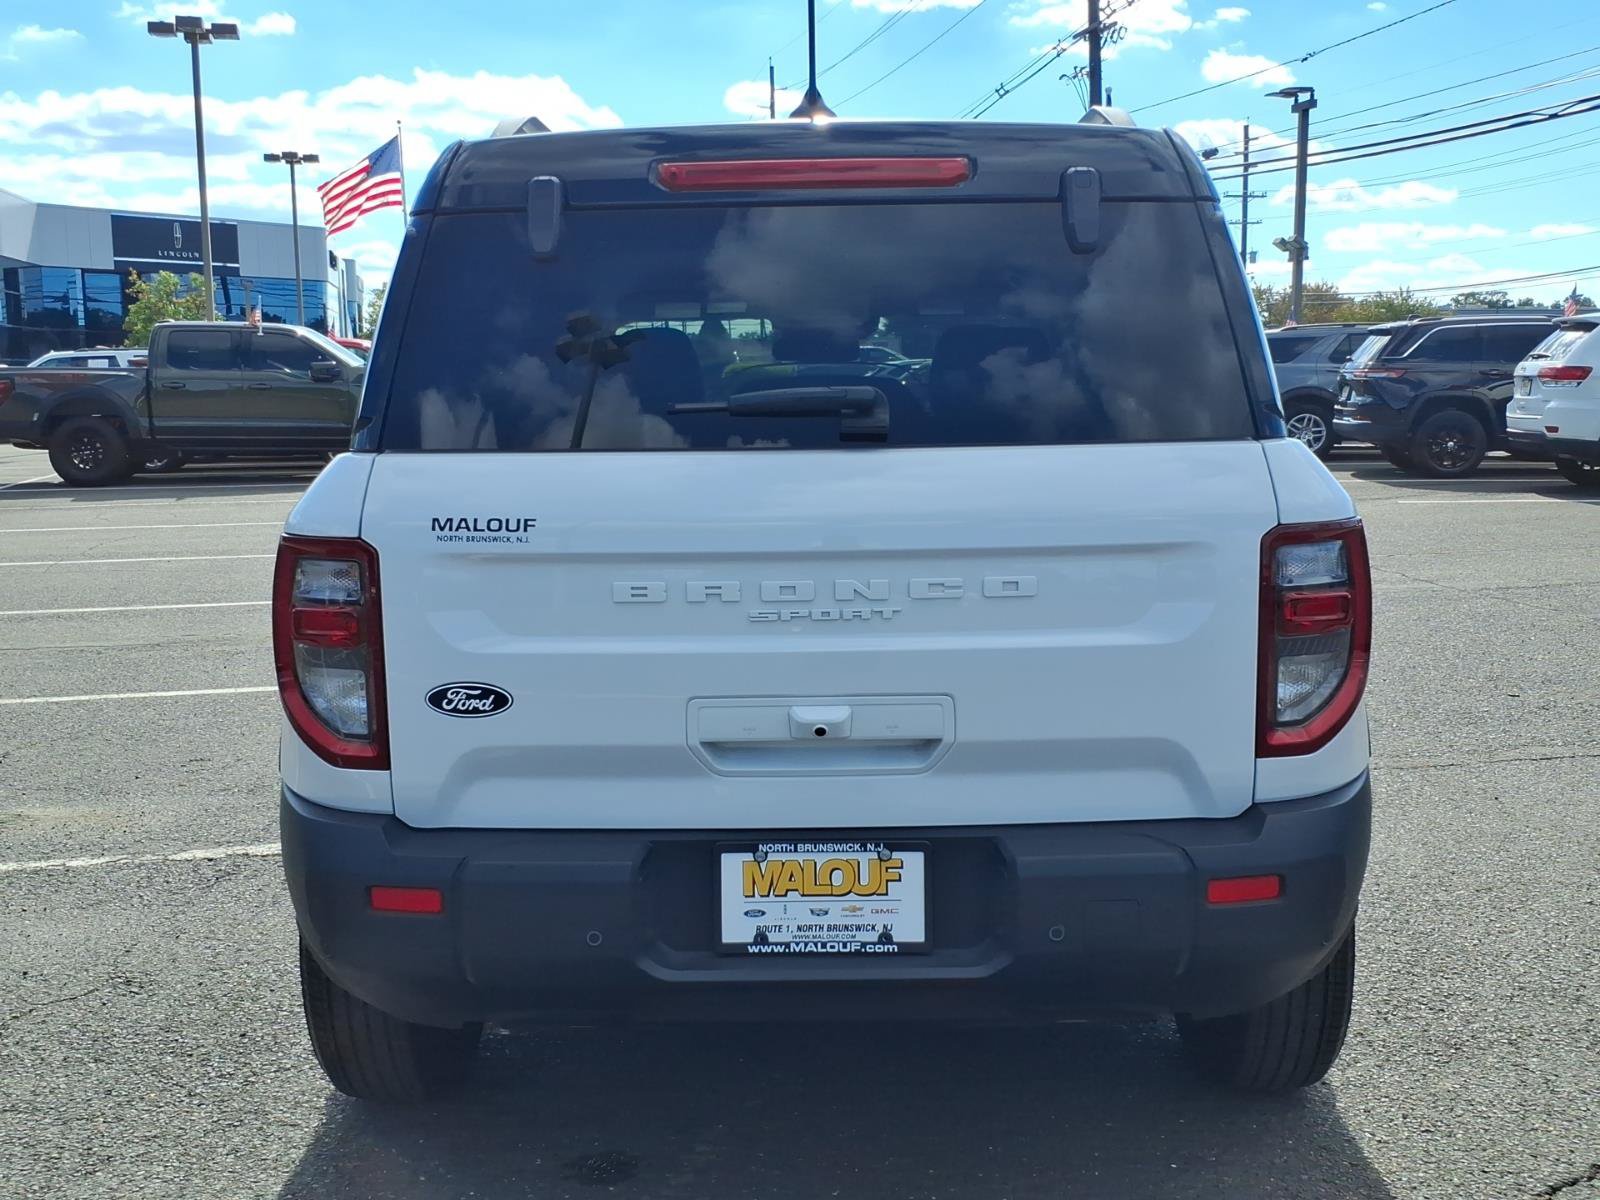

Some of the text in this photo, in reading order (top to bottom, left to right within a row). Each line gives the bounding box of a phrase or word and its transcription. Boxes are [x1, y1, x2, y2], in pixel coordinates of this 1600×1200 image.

[158, 250, 199, 258] LINCOLN
[431, 517, 537, 533] MALOUF
[436, 535, 463, 543] NORTH
[466, 535, 514, 544] BRUNSWICK,
[612, 575, 1038, 603] BRONCO
[747, 606, 902, 622] SPORT
[442, 688, 495, 710] Ford
[758, 844, 794, 852] NORTH
[797, 843, 864, 853] BRUNSWICK,
[742, 858, 904, 898] MALOUF
[755, 923, 893, 934] ROUTE 1, NORTH BRUNSWICK, NJ
[747, 941, 898, 953] www.MALOUF.com
